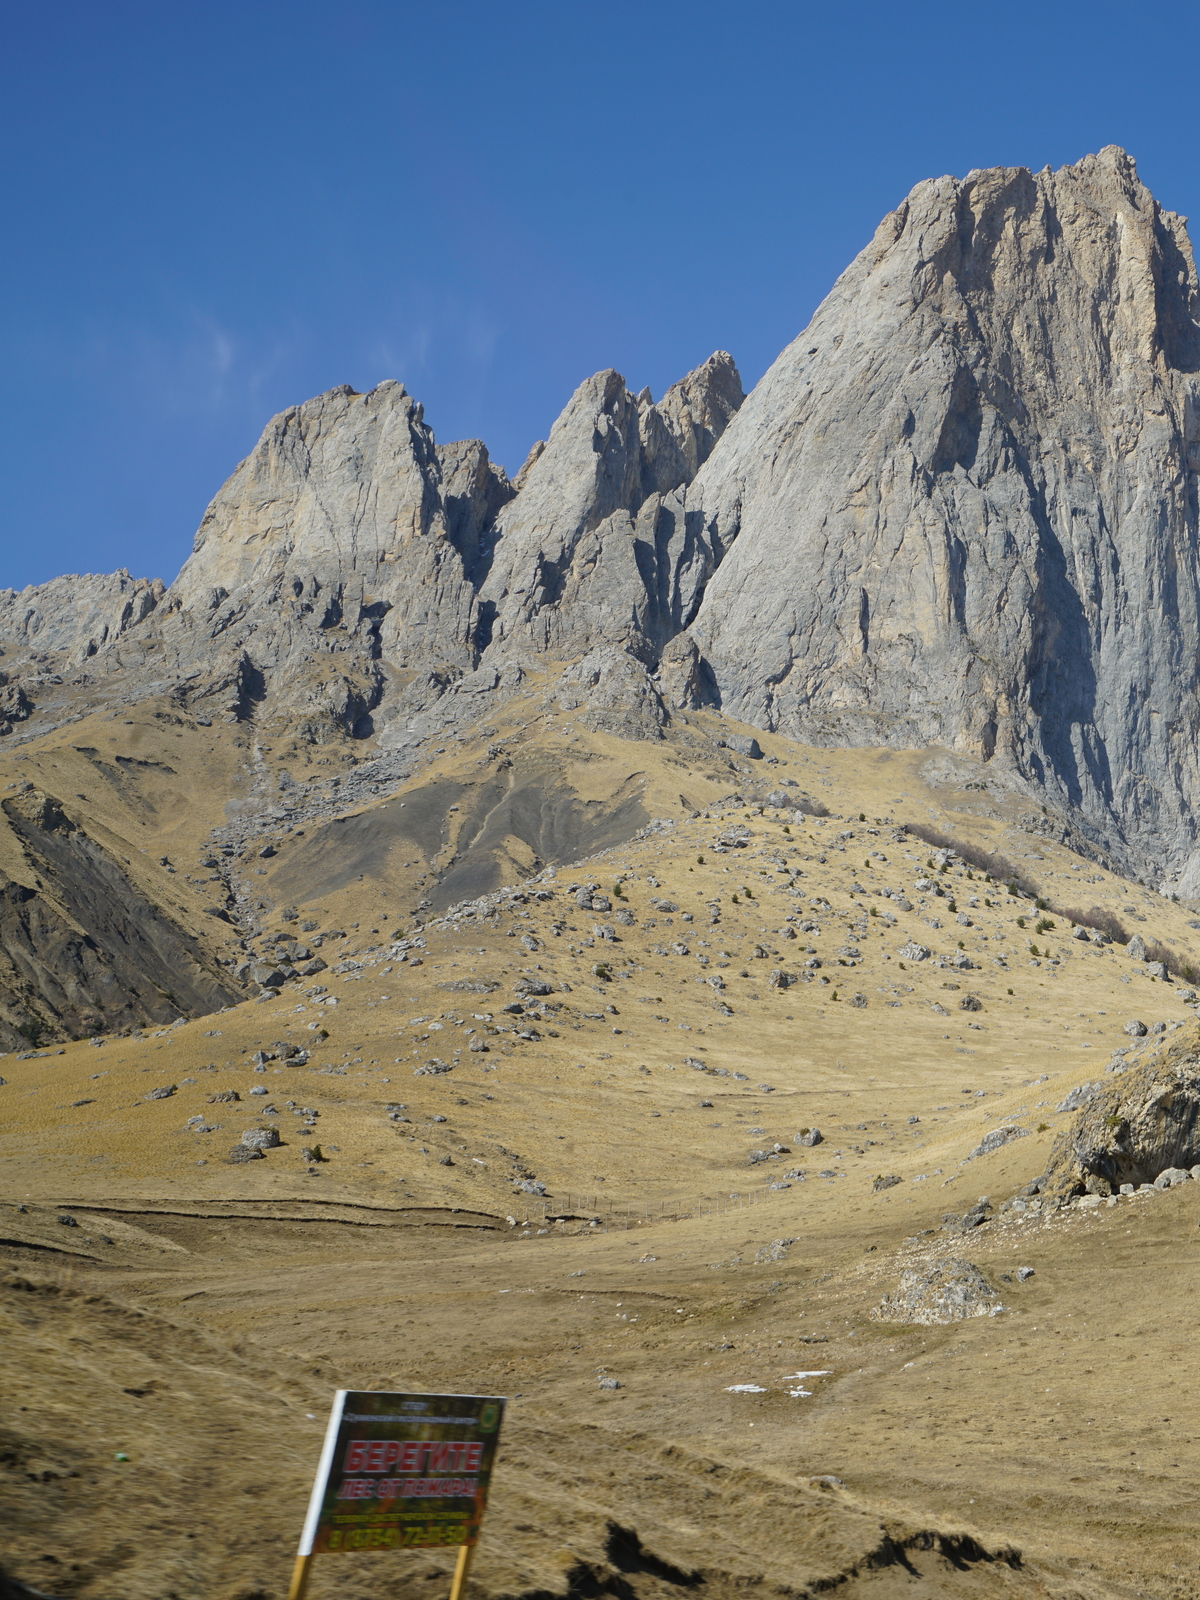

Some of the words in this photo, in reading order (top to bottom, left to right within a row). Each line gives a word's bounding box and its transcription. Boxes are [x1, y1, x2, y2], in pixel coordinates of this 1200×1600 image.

[343, 1440, 484, 1473] БЕРЕГИТЕ
[336, 1479, 375, 1499] ЛЕС
[376, 1478, 402, 1499] ОТ
[402, 1478, 478, 1498] ПОЖАРА!
[329, 1529, 341, 1549] 8
